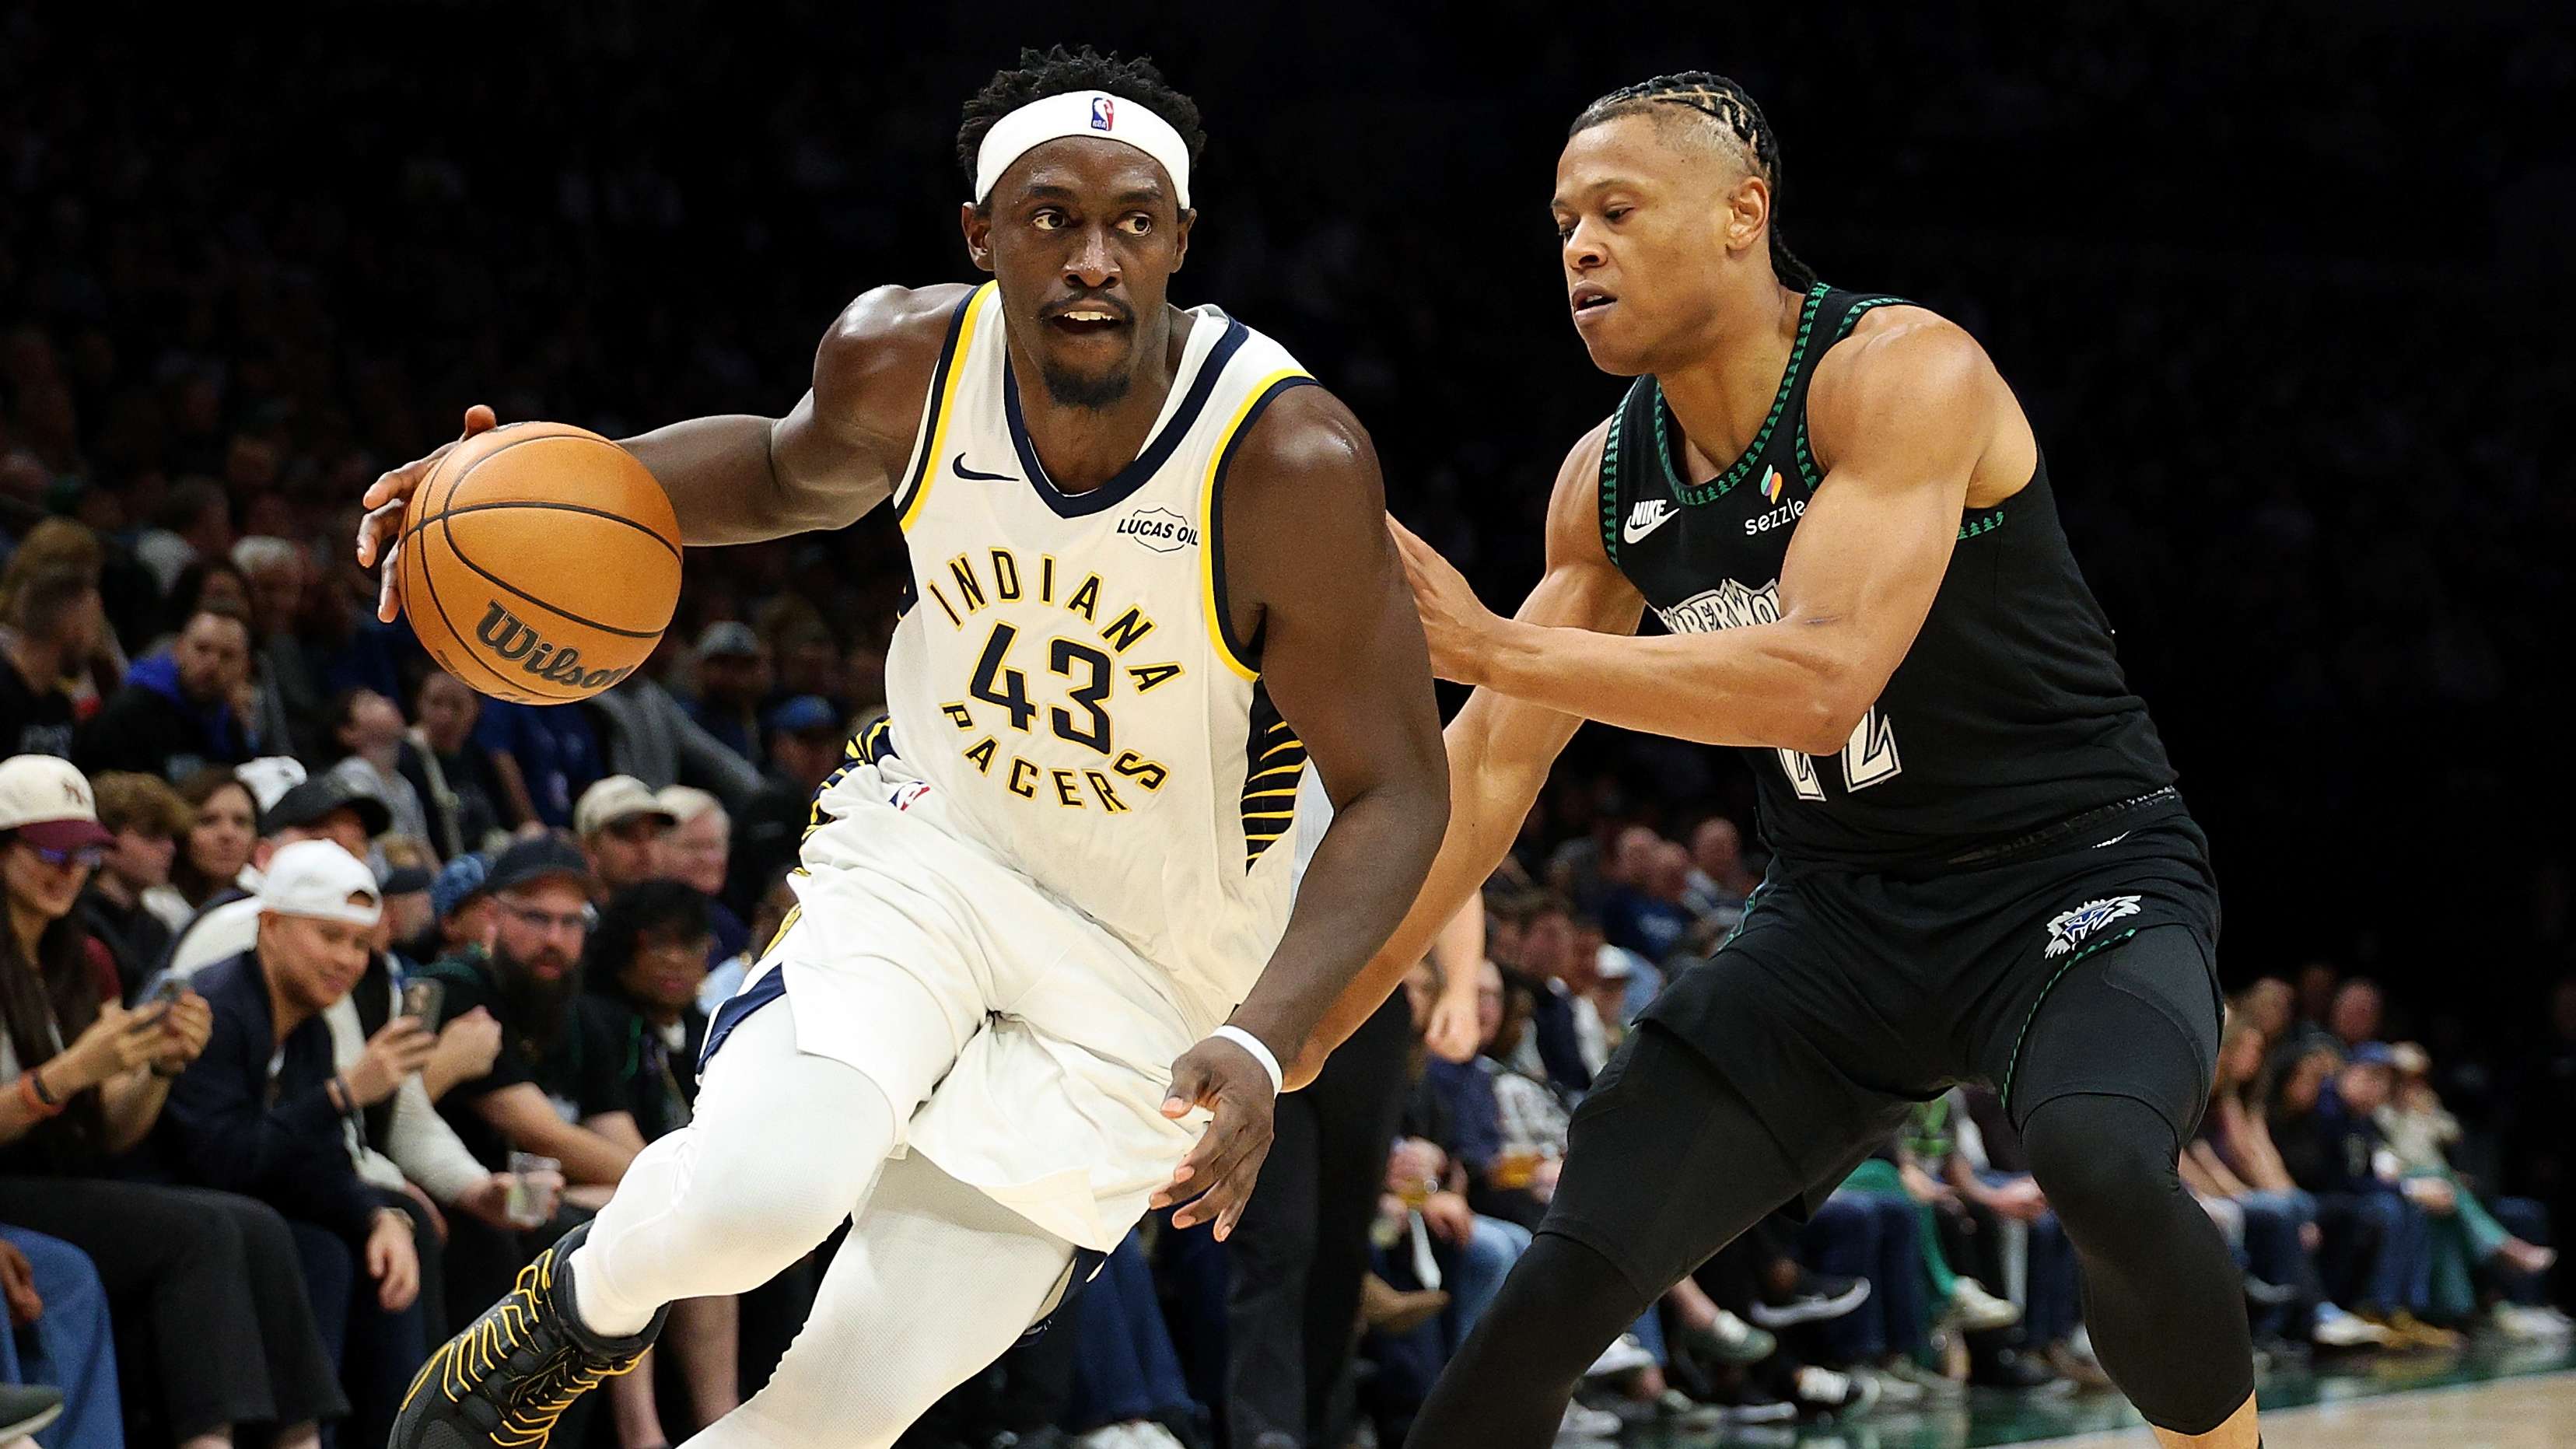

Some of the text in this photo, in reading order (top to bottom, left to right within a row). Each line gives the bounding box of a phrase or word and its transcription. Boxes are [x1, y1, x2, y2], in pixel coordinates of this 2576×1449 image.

[1117, 519, 1198, 546] LUCAS OIL
[1631, 499, 1667, 526] NIKE
[1745, 498, 1806, 536] sezzle
[476, 598, 635, 689] Wilson
[927, 547, 1185, 694] INDIANA
[970, 620, 1116, 755] 43
[940, 701, 1171, 814] PACERS
